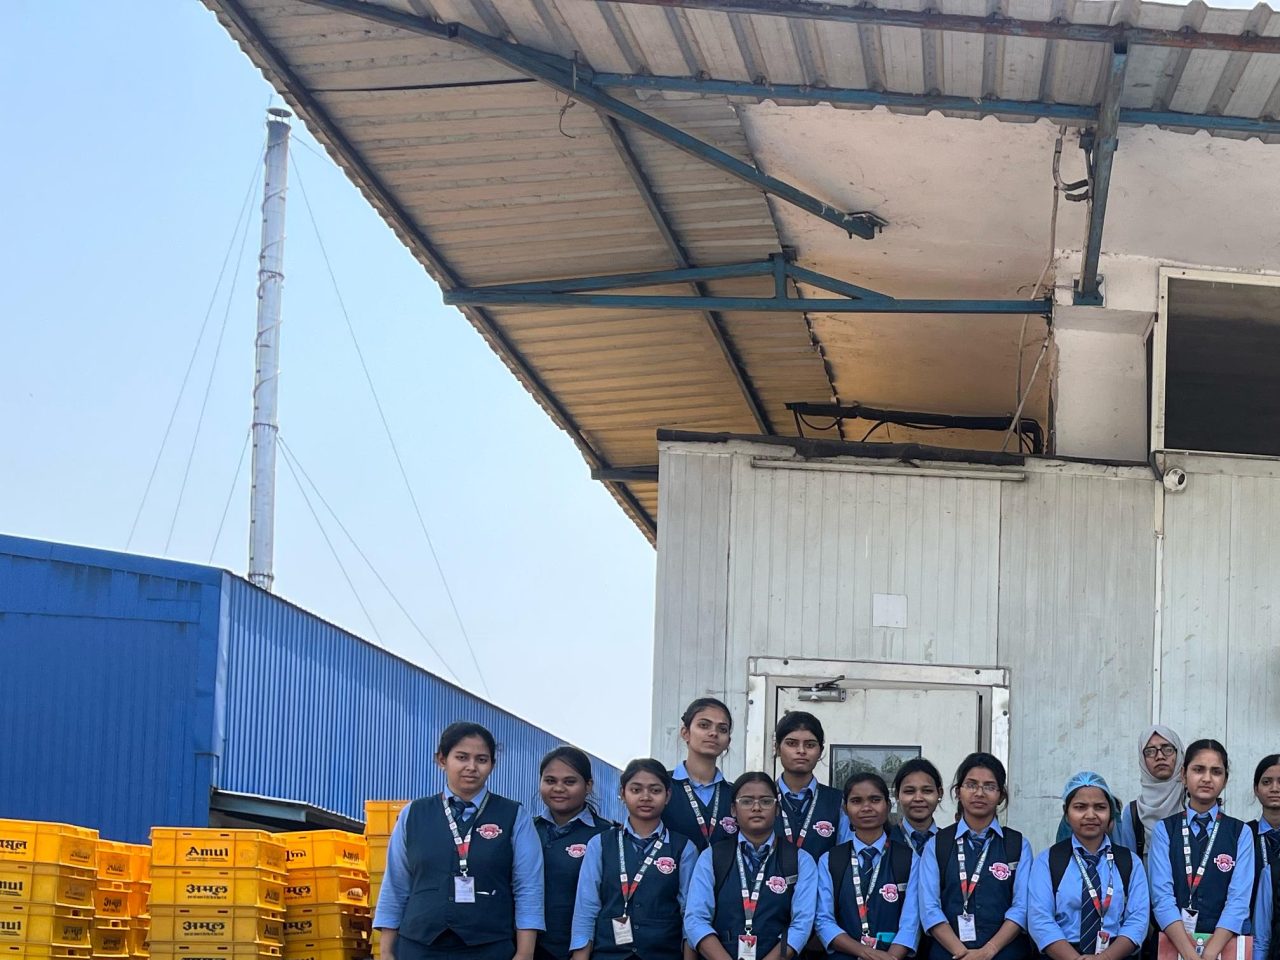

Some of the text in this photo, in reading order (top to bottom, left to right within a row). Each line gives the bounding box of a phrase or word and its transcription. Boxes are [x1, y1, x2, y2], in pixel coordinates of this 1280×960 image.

[186, 846, 229, 857] Amul
[186, 884, 228, 895] अमूल
[183, 921, 225, 932] अमूल
